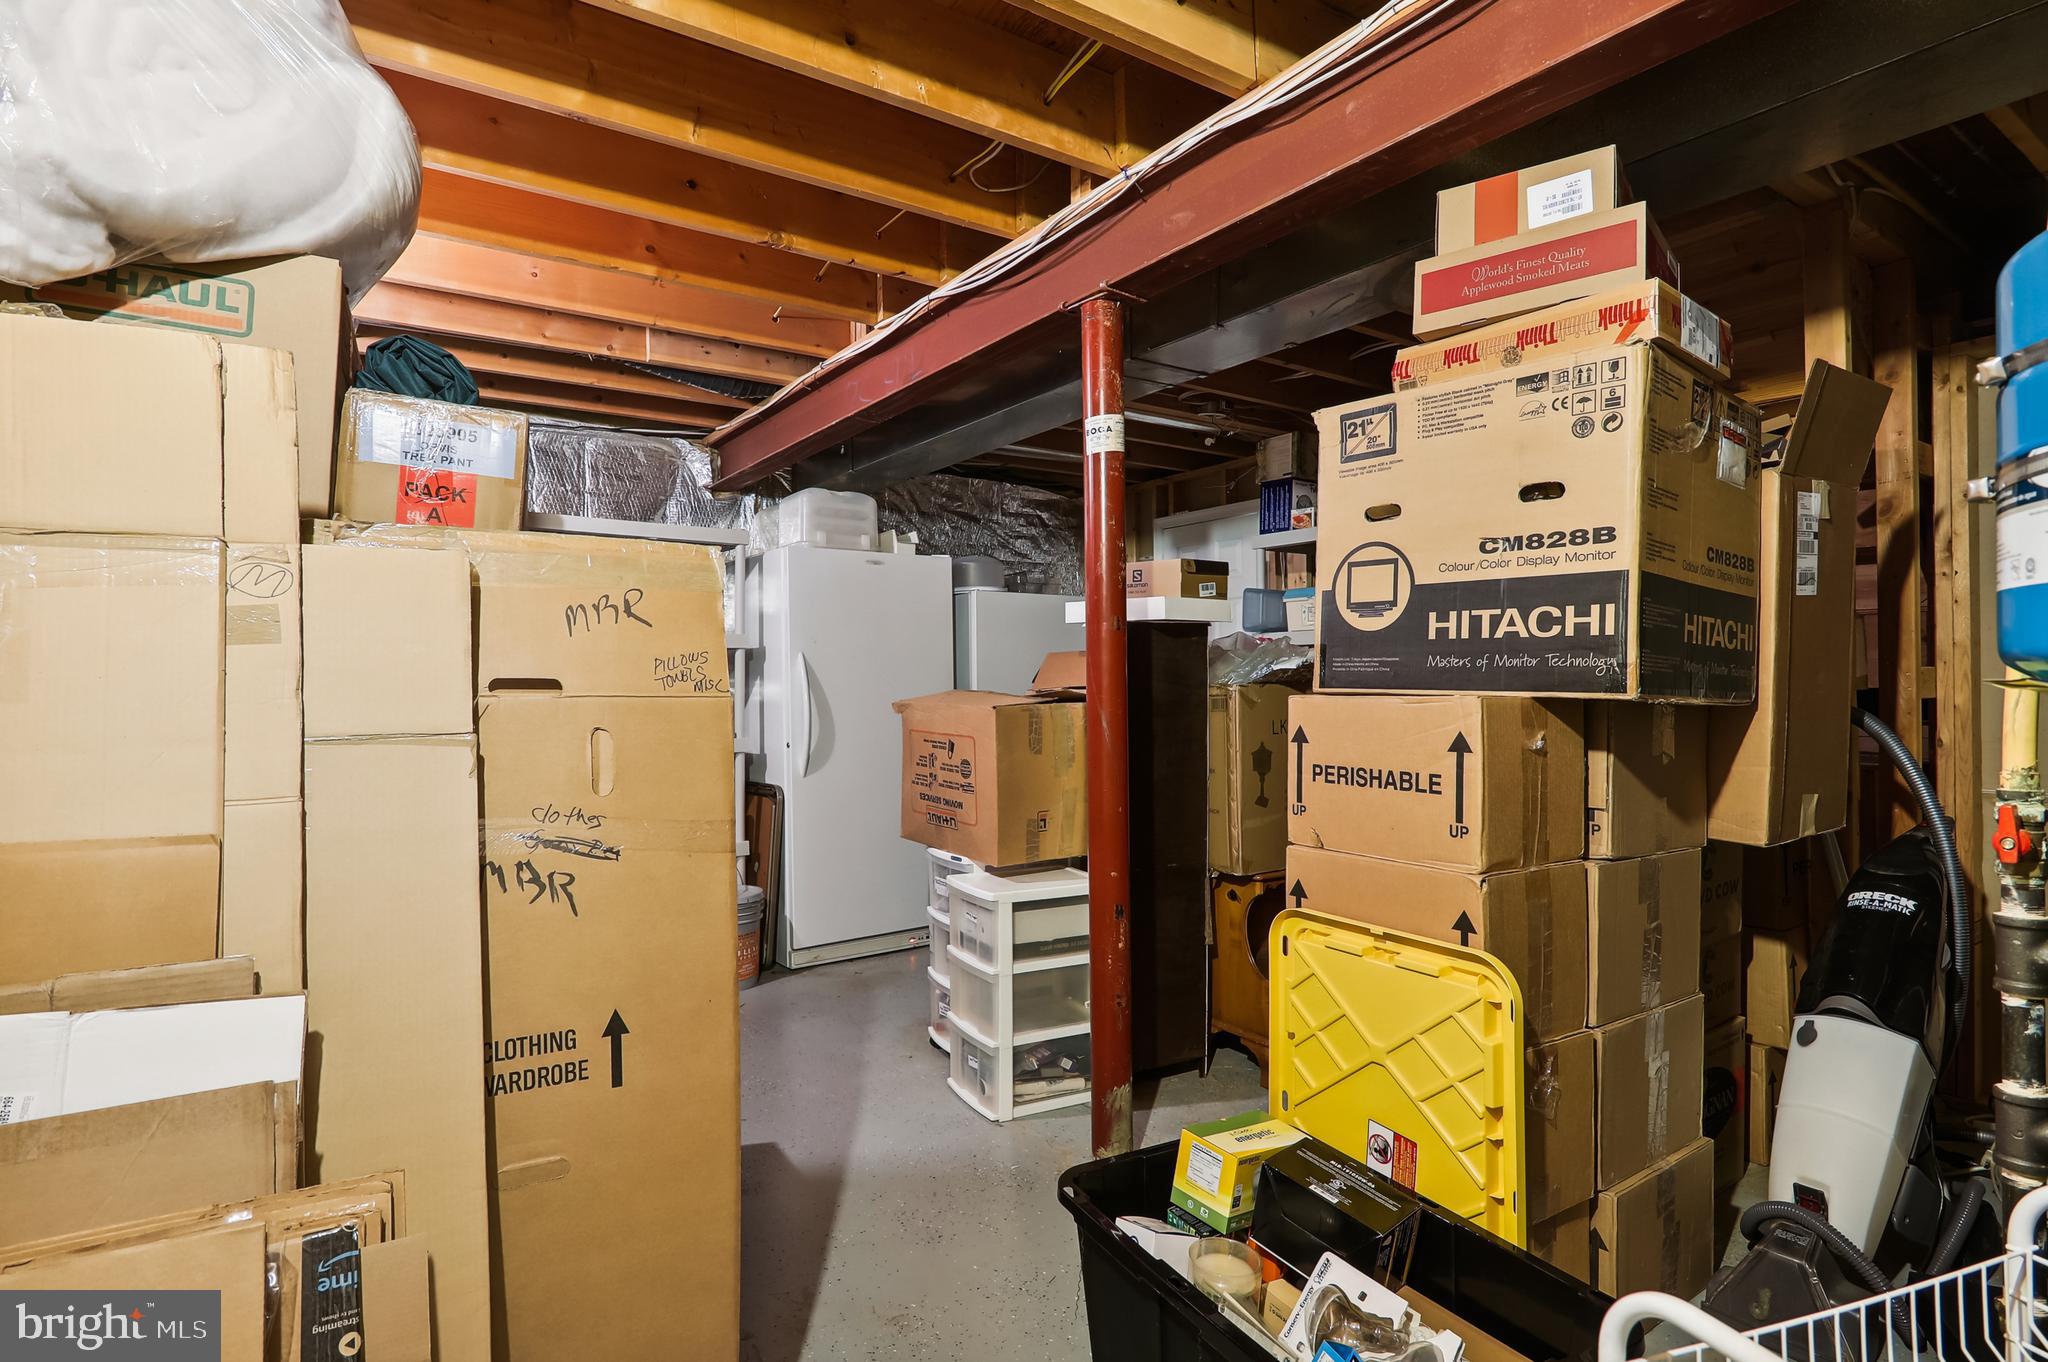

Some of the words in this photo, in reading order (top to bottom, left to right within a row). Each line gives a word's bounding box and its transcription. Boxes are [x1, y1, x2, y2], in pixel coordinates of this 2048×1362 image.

[1471, 263, 1514, 282] World's
[1516, 256, 1545, 271] Finest
[1548, 247, 1586, 263] Quality
[1461, 274, 1514, 297] Applewood
[1516, 264, 1556, 284] Smoked
[1558, 259, 1590, 274] Meats
[62, 267, 240, 314] -HAUL
[1598, 298, 1643, 331] Think
[1516, 322, 1558, 350] Think
[1443, 342, 1481, 369] Think
[1517, 380, 1548, 392] ENERGY
[1609, 388, 1616, 396] 6
[440, 455, 474, 468] PANT
[404, 482, 466, 503] PACK
[426, 507, 442, 523] A
[1479, 526, 1617, 554] CM828B
[1516, 553, 1560, 567] Display
[1564, 549, 1617, 564] Monitor
[1706, 546, 1755, 573] CM828B
[1427, 603, 1616, 640] HITACHI
[1684, 612, 1754, 652] HITACHI
[654, 651, 709, 675] PILLOWS
[1427, 653, 1471, 667] Masters
[1476, 653, 1489, 671] of
[1494, 653, 1541, 667] Monitor
[1545, 652, 1620, 676] Technology
[694, 679, 730, 693] MISC
[1272, 720, 1288, 735] LK
[1312, 763, 1442, 795] PERISHABLE
[919, 792, 942, 805] SERVICES
[942, 798, 964, 810] MOVING
[1292, 804, 1306, 816] UP
[1449, 824, 1469, 839] UP
[1847, 899, 1913, 916] RINSE-A-MATIC
[1848, 891, 1918, 911] ORECK
[484, 1029, 577, 1064] CLOTHING
[1235, 1129, 1275, 1143] energetic
[312, 1316, 359, 1334] streaming
